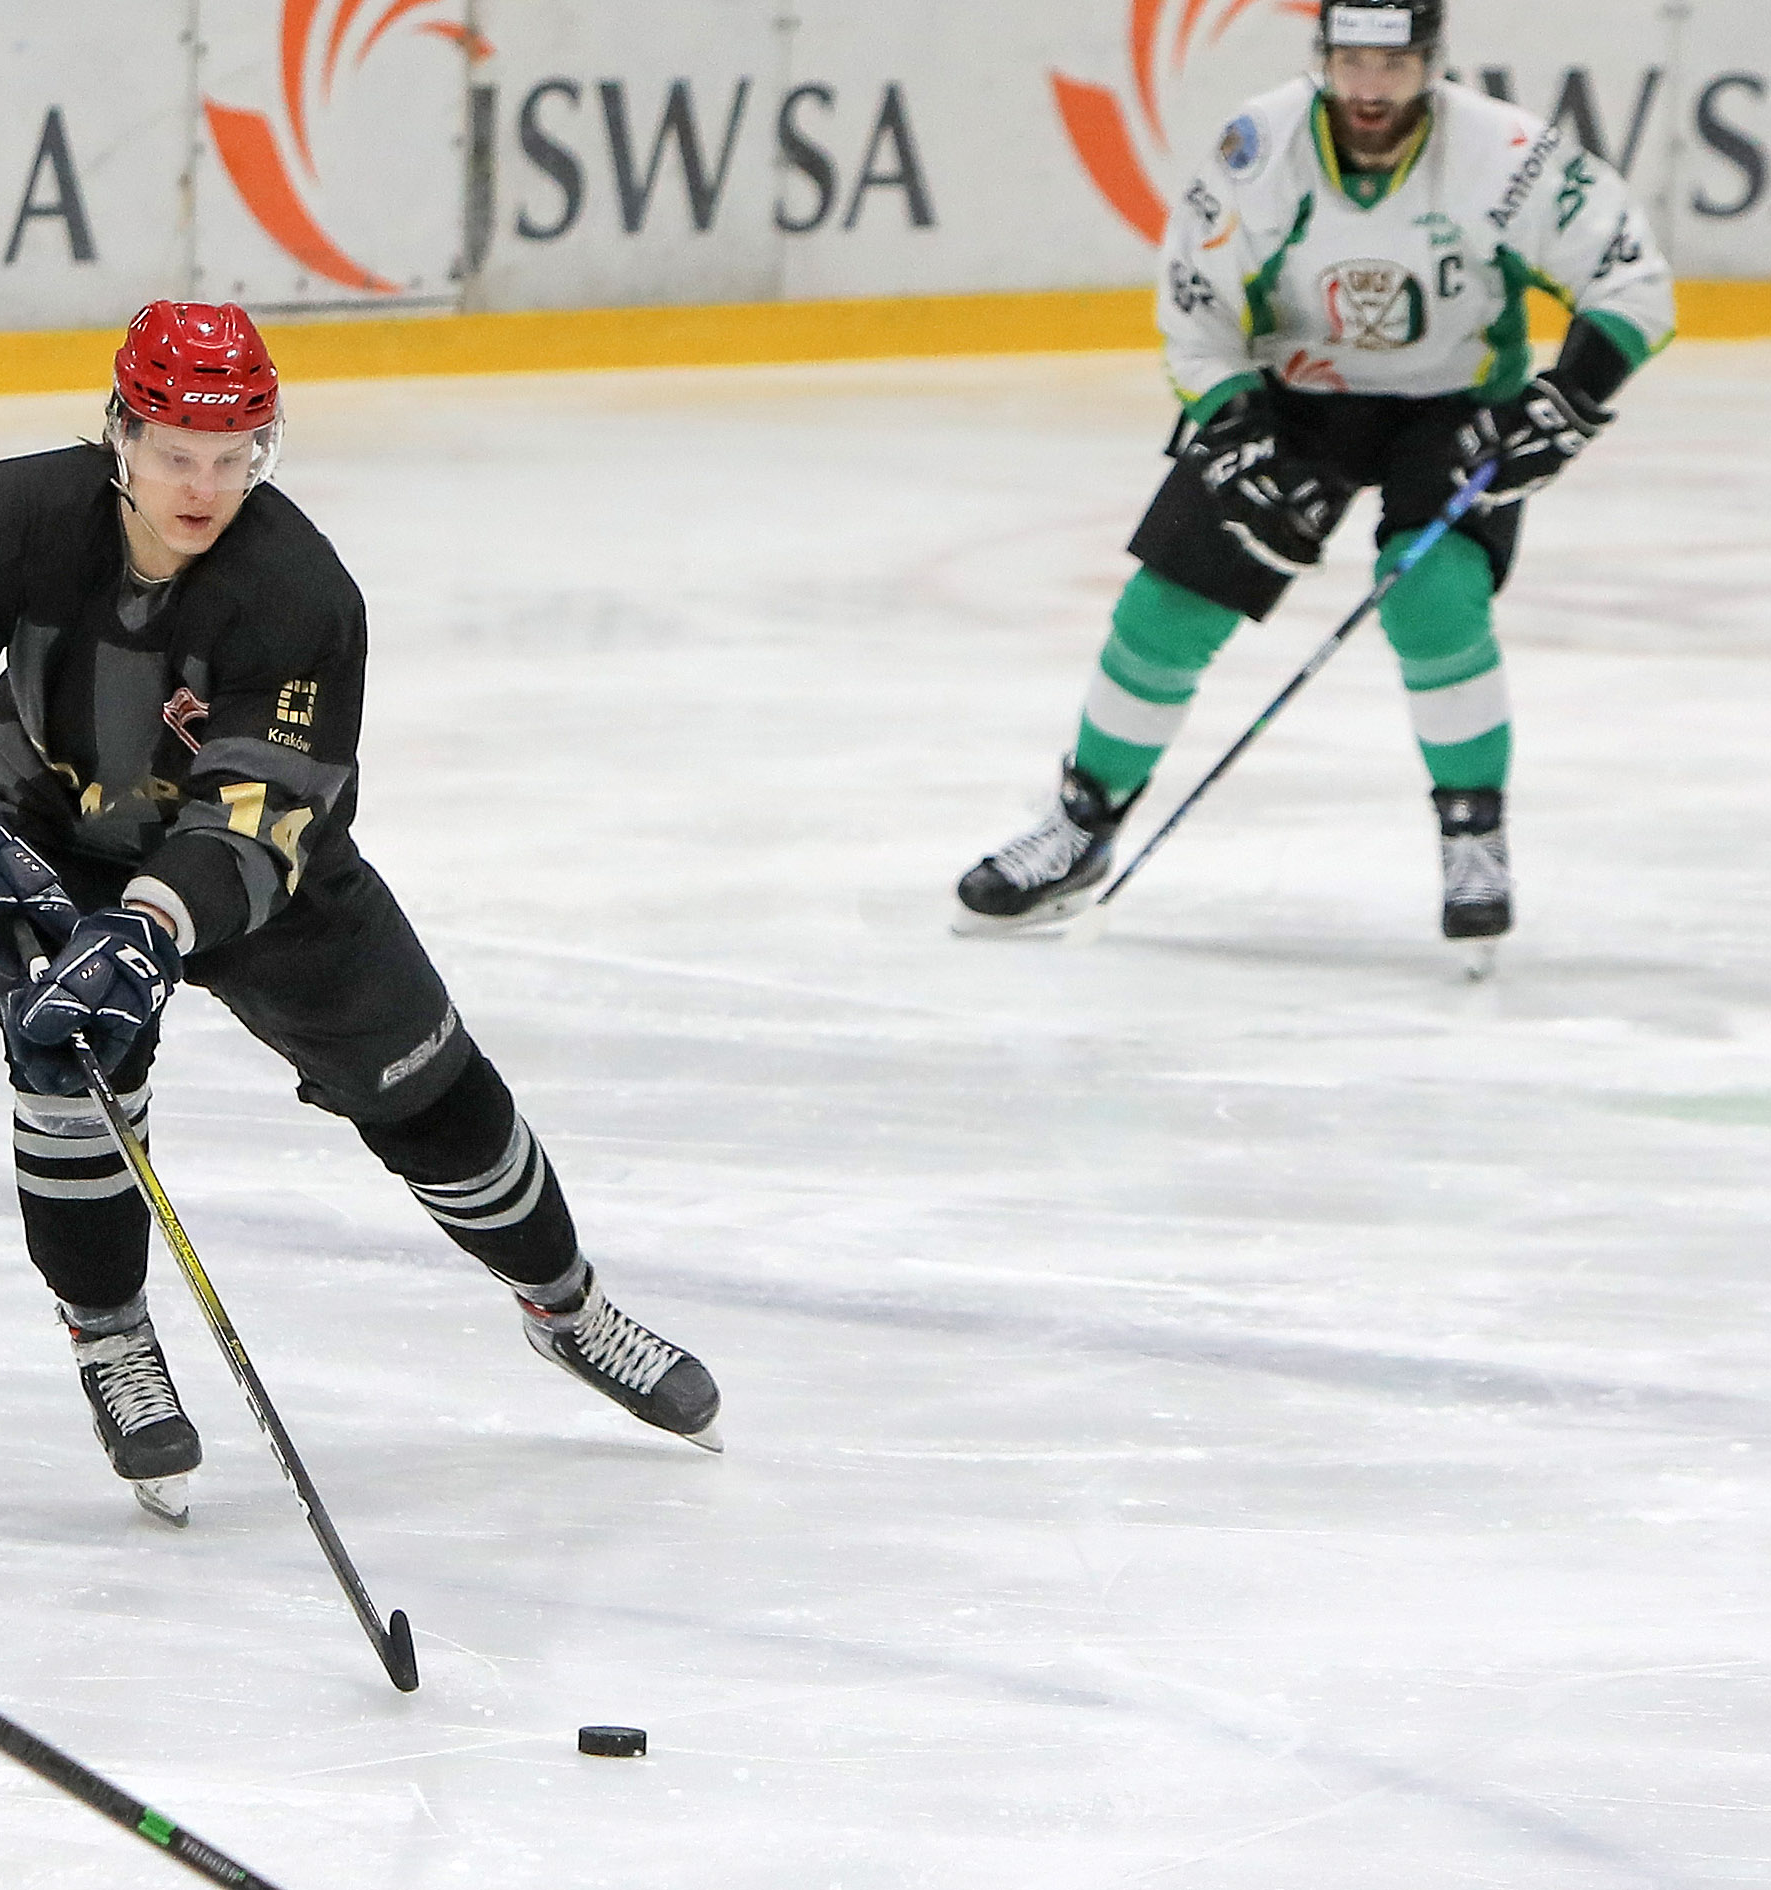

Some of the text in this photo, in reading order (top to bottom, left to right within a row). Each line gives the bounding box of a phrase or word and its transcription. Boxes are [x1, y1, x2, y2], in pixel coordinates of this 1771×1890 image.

[449, 77, 937, 280] JSW SA
[1439, 256, 1464, 299] C
[182, 391, 240, 405] CCM
[268, 727, 312, 753] Kraków
